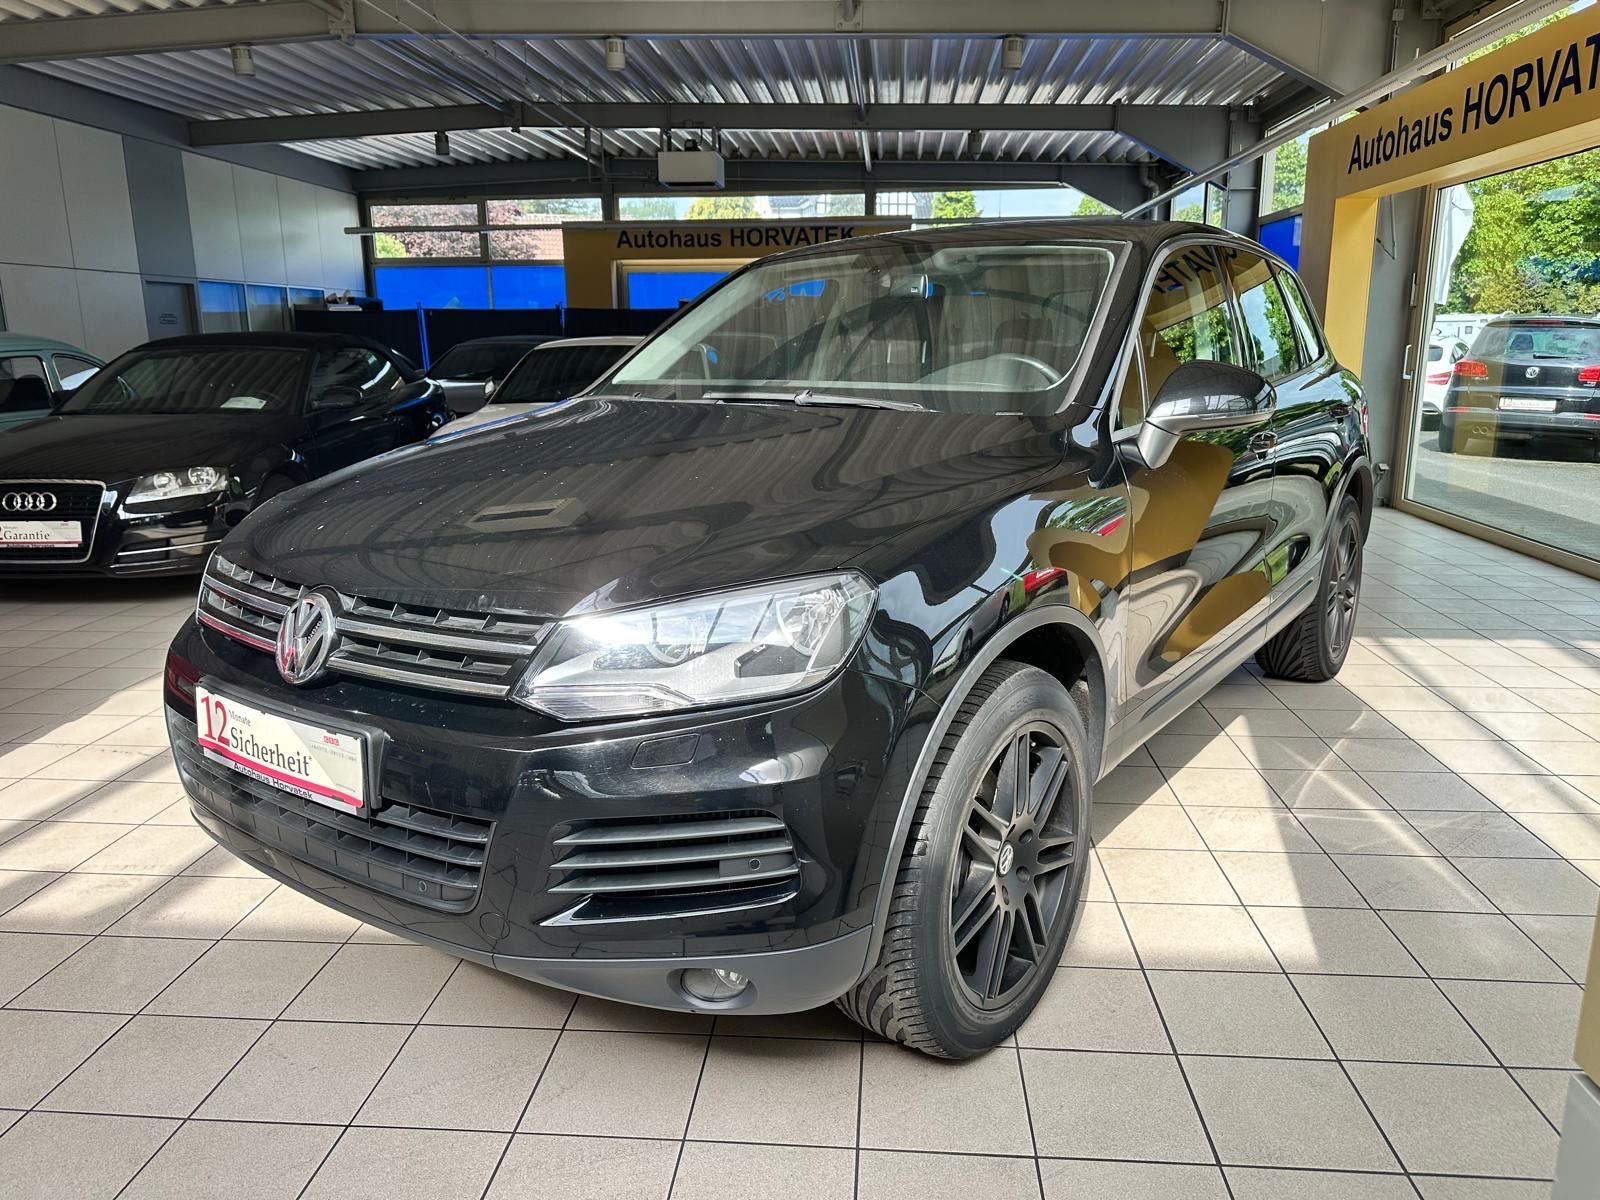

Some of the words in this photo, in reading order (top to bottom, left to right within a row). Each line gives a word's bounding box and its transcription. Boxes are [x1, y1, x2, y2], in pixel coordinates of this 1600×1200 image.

[1347, 106, 1453, 175] Autohaus
[616, 230, 722, 248] Autohaus
[3, 530, 50, 540] Garantie
[201, 695, 230, 747] 12
[233, 762, 271, 785] Autohaus
[272, 778, 313, 800] Horvatek
